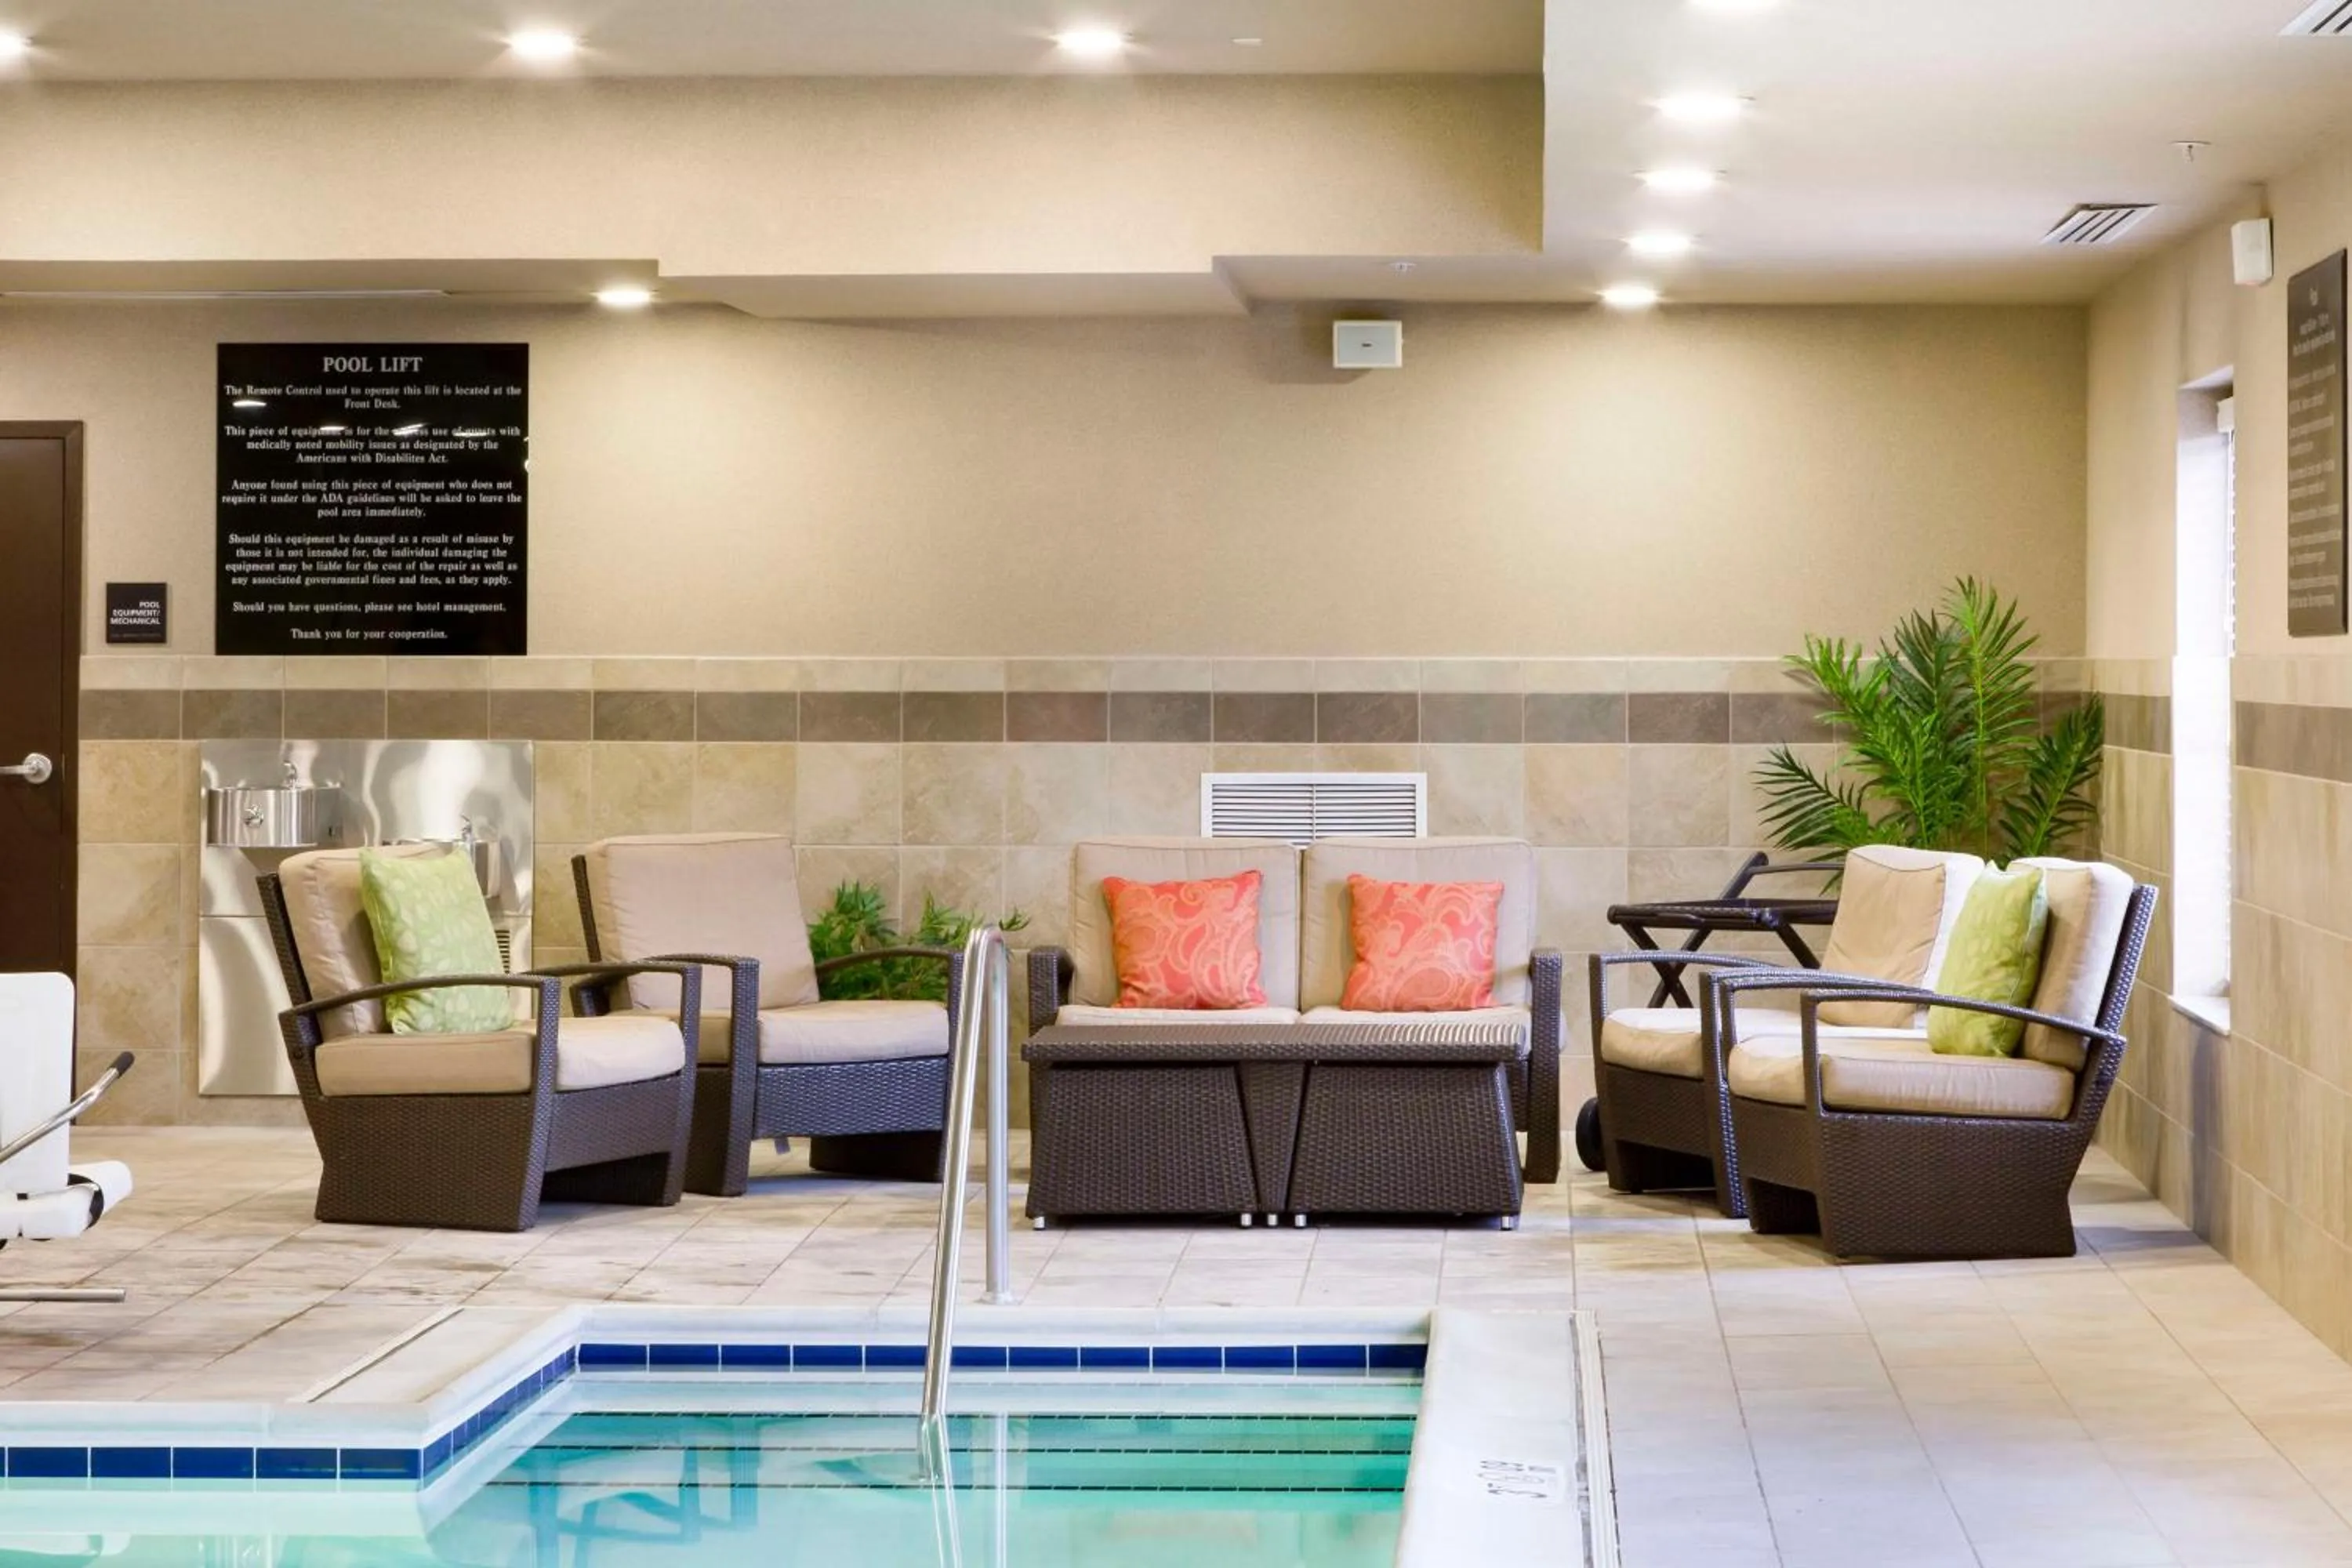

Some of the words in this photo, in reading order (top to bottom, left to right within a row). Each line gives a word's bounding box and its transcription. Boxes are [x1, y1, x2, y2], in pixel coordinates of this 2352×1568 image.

[323, 357, 373, 372] POOL
[380, 357, 423, 372] LIFT
[225, 385, 243, 397] The
[246, 385, 282, 396] Remote
[285, 385, 322, 396] Control
[325, 386, 347, 395] used
[365, 388, 400, 397] operate
[403, 386, 421, 395] this
[424, 386, 439, 395] lift
[443, 386, 452, 394] is
[455, 386, 490, 395] located
[493, 387, 503, 396] at
[506, 386, 521, 396] the
[344, 398, 370, 408] Front
[225, 426, 245, 436] This
[249, 426, 274, 437] piece
[278, 426, 288, 436] of
[357, 426, 370, 436] for
[374, 426, 390, 436] the
[499, 426, 521, 436] with
[246, 439, 291, 451] medically
[295, 440, 322, 449] noted
[325, 439, 365, 451] mobility
[368, 441, 397, 449] issues
[413, 440, 465, 452] designated
[467, 440, 480, 451] by
[483, 440, 499, 450] the
[296, 453, 347, 463] Americans
[350, 453, 372, 463] with
[231, 480, 267, 492] Anyone
[270, 480, 299, 490] found
[301, 480, 328, 492] using
[331, 480, 350, 490] this
[352, 480, 379, 492] piece
[381, 480, 392, 490] of
[394, 480, 445, 492] equipment
[448, 480, 468, 490] who
[470, 480, 493, 490] does
[495, 481, 513, 490] not
[221, 493, 257, 506] require
[260, 494, 267, 503] it
[270, 494, 299, 503] under
[301, 493, 318, 503] the
[320, 493, 344, 503] ADA
[347, 493, 396, 506] guidelines
[398, 493, 417, 503] will
[419, 494, 432, 503] be
[434, 493, 463, 503] asked
[479, 493, 504, 503] leave
[506, 493, 522, 503] the
[317, 507, 339, 520] pool
[228, 534, 261, 544] Should
[263, 534, 283, 544] this
[285, 535, 336, 546] equipment
[338, 535, 351, 544] be
[353, 535, 396, 546] damaged
[421, 534, 449, 544] result
[452, 534, 463, 543] of
[466, 535, 499, 544] misuse
[502, 534, 515, 545] by
[235, 548, 262, 557] those
[264, 548, 273, 557] it
[275, 548, 285, 557] is
[307, 547, 349, 557] intended
[372, 547, 388, 557] the
[391, 547, 439, 557] individual
[441, 547, 489, 559] damaging
[492, 547, 508, 557] the
[224, 561, 275, 573] equipment
[278, 564, 298, 573] may
[301, 561, 314, 572] be
[316, 561, 343, 572] liable
[345, 561, 361, 571] for
[363, 561, 379, 572] the
[382, 563, 402, 572] cost
[405, 561, 416, 571] of
[419, 561, 435, 572] the
[438, 561, 467, 573] repair
[484, 561, 504, 571] well
[231, 577, 249, 586] any
[252, 575, 302, 585] associated
[304, 575, 369, 586] governmental
[372, 575, 396, 585] fines
[398, 575, 417, 585] and
[459, 575, 479, 586] they
[232, 602, 265, 612] Should
[267, 604, 285, 613] you
[288, 602, 310, 612] have
[364, 602, 394, 614] please
[416, 602, 441, 612] hotel
[289, 628, 322, 639] Thank
[325, 631, 343, 641] you
[345, 629, 361, 639] for
[363, 631, 386, 640] your
